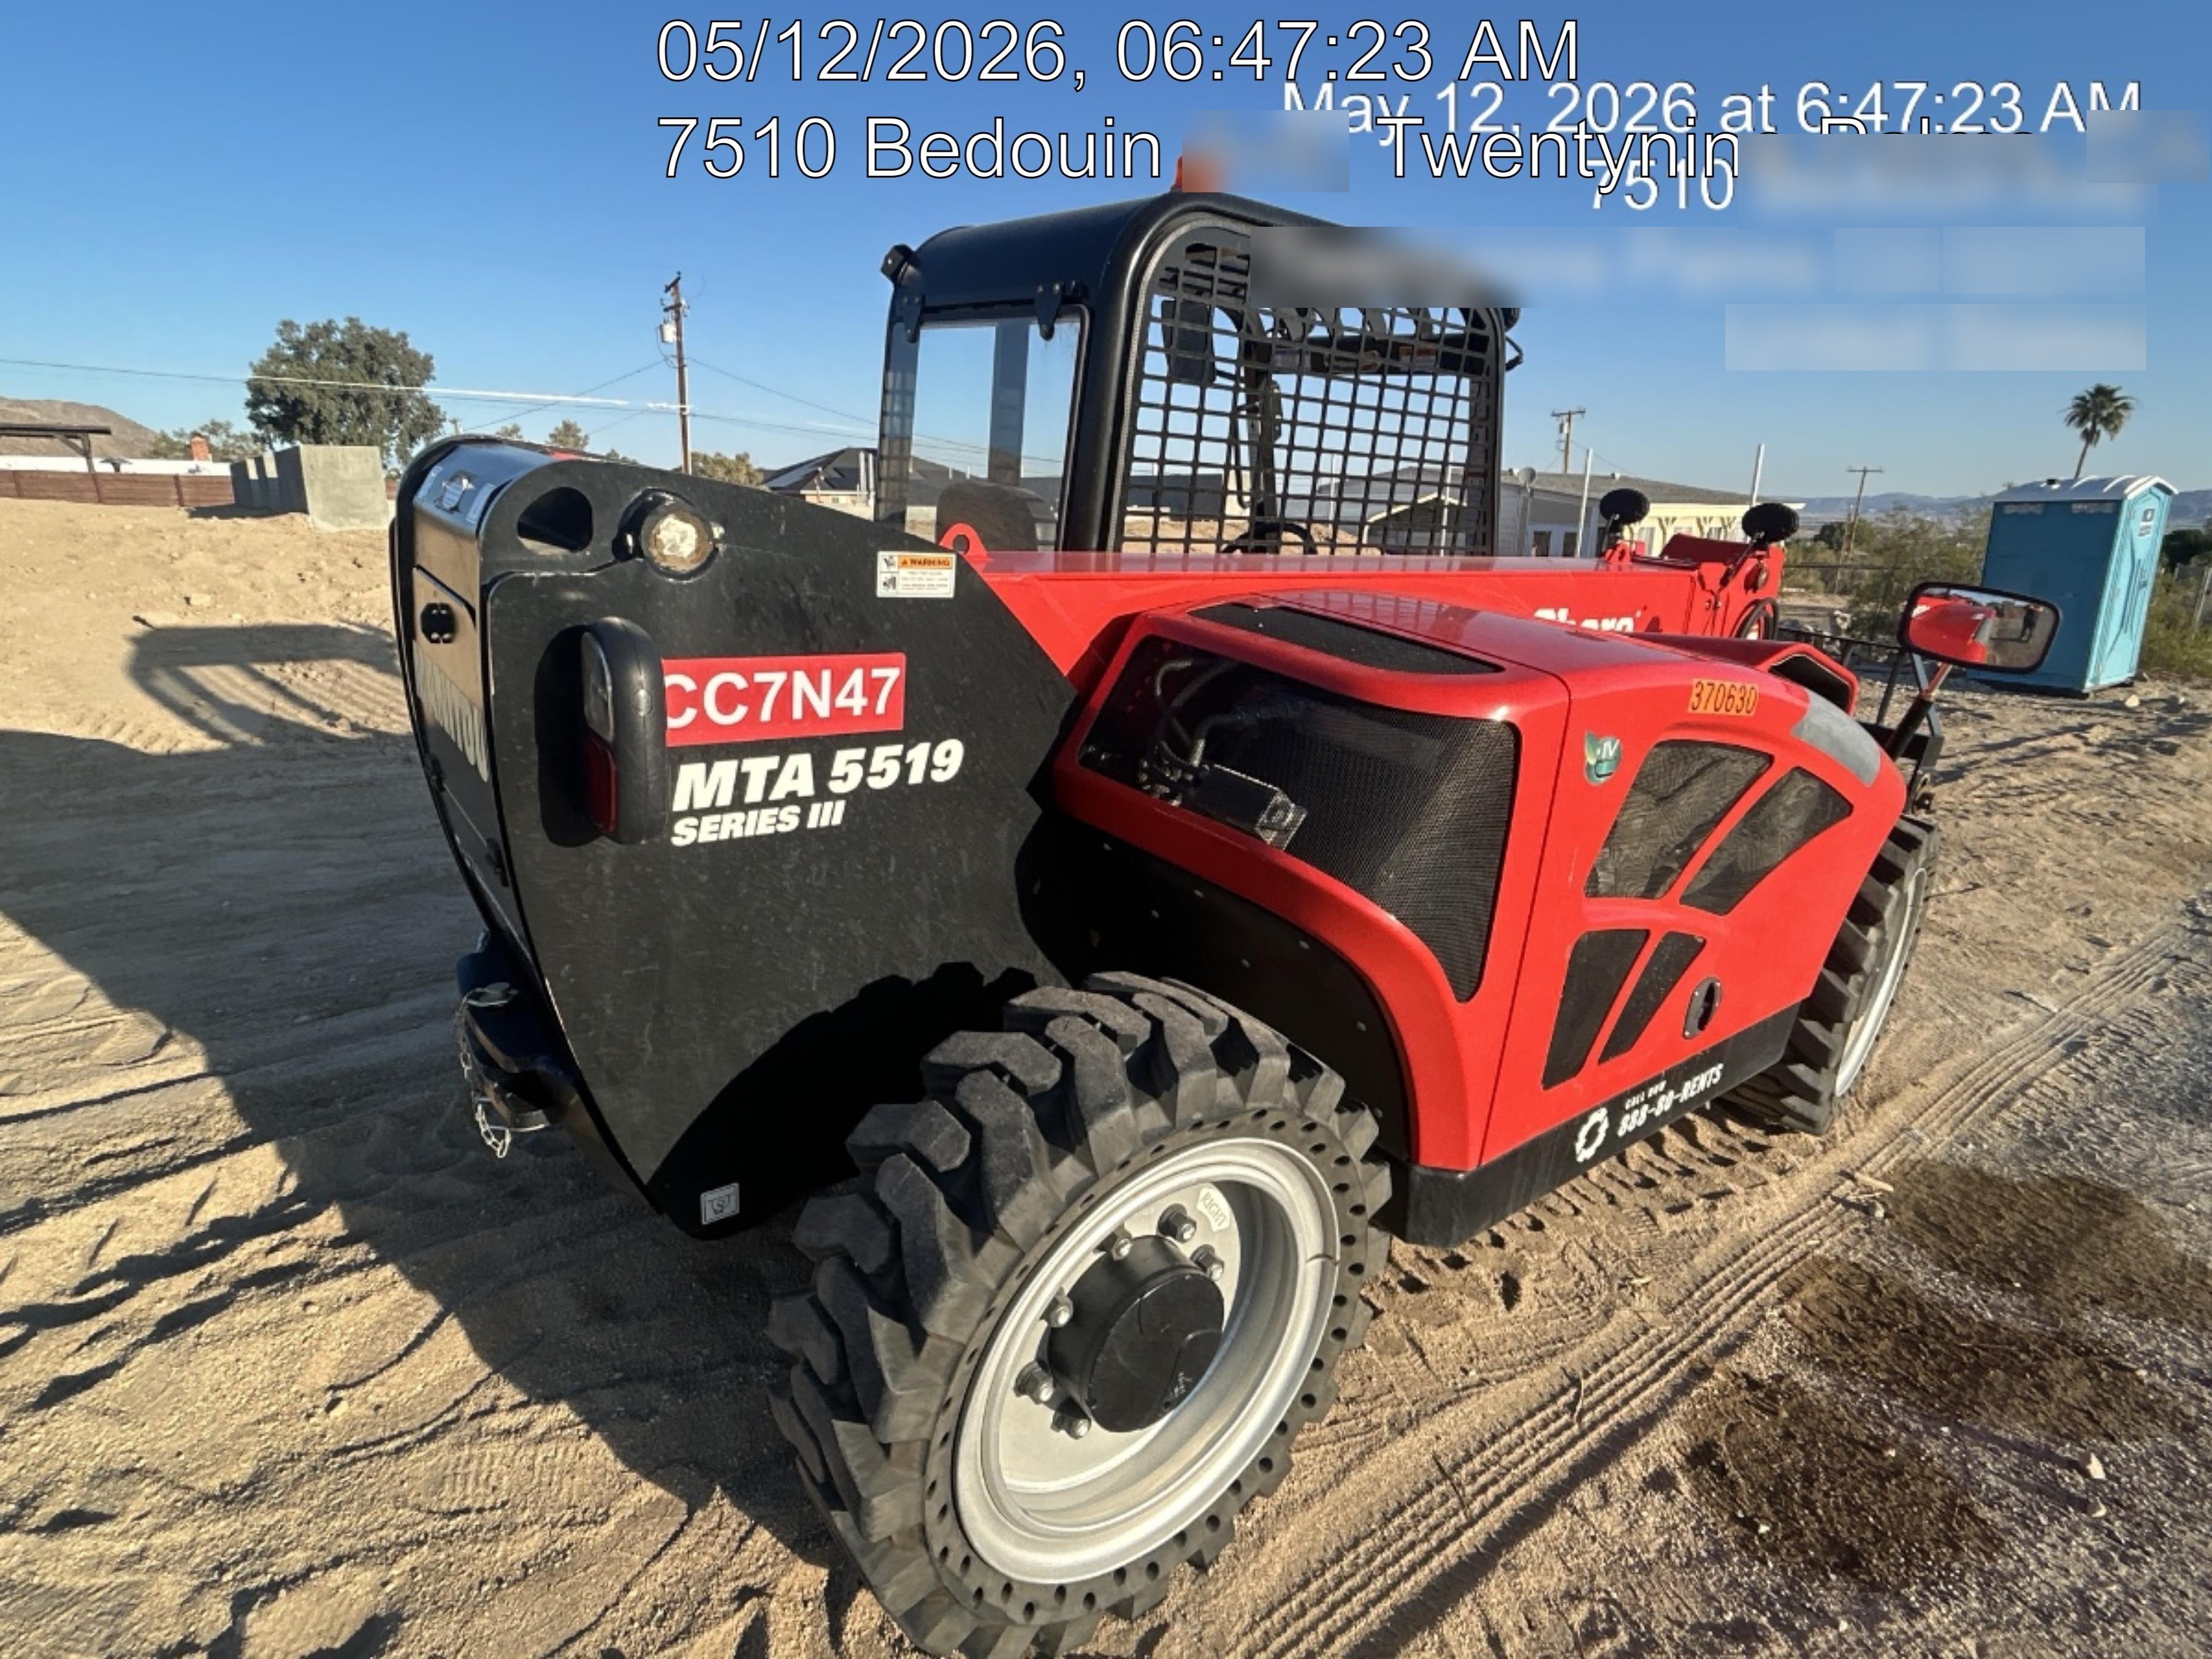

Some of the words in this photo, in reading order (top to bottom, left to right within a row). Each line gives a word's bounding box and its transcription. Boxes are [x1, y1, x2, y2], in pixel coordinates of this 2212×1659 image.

[664, 666, 901, 729] CC7N47
[1691, 681, 1757, 714] 370630
[672, 753, 815, 812] MTA
[828, 739, 965, 794] 5519
[671, 806, 801, 847] SERIES
[807, 800, 846, 829] III
